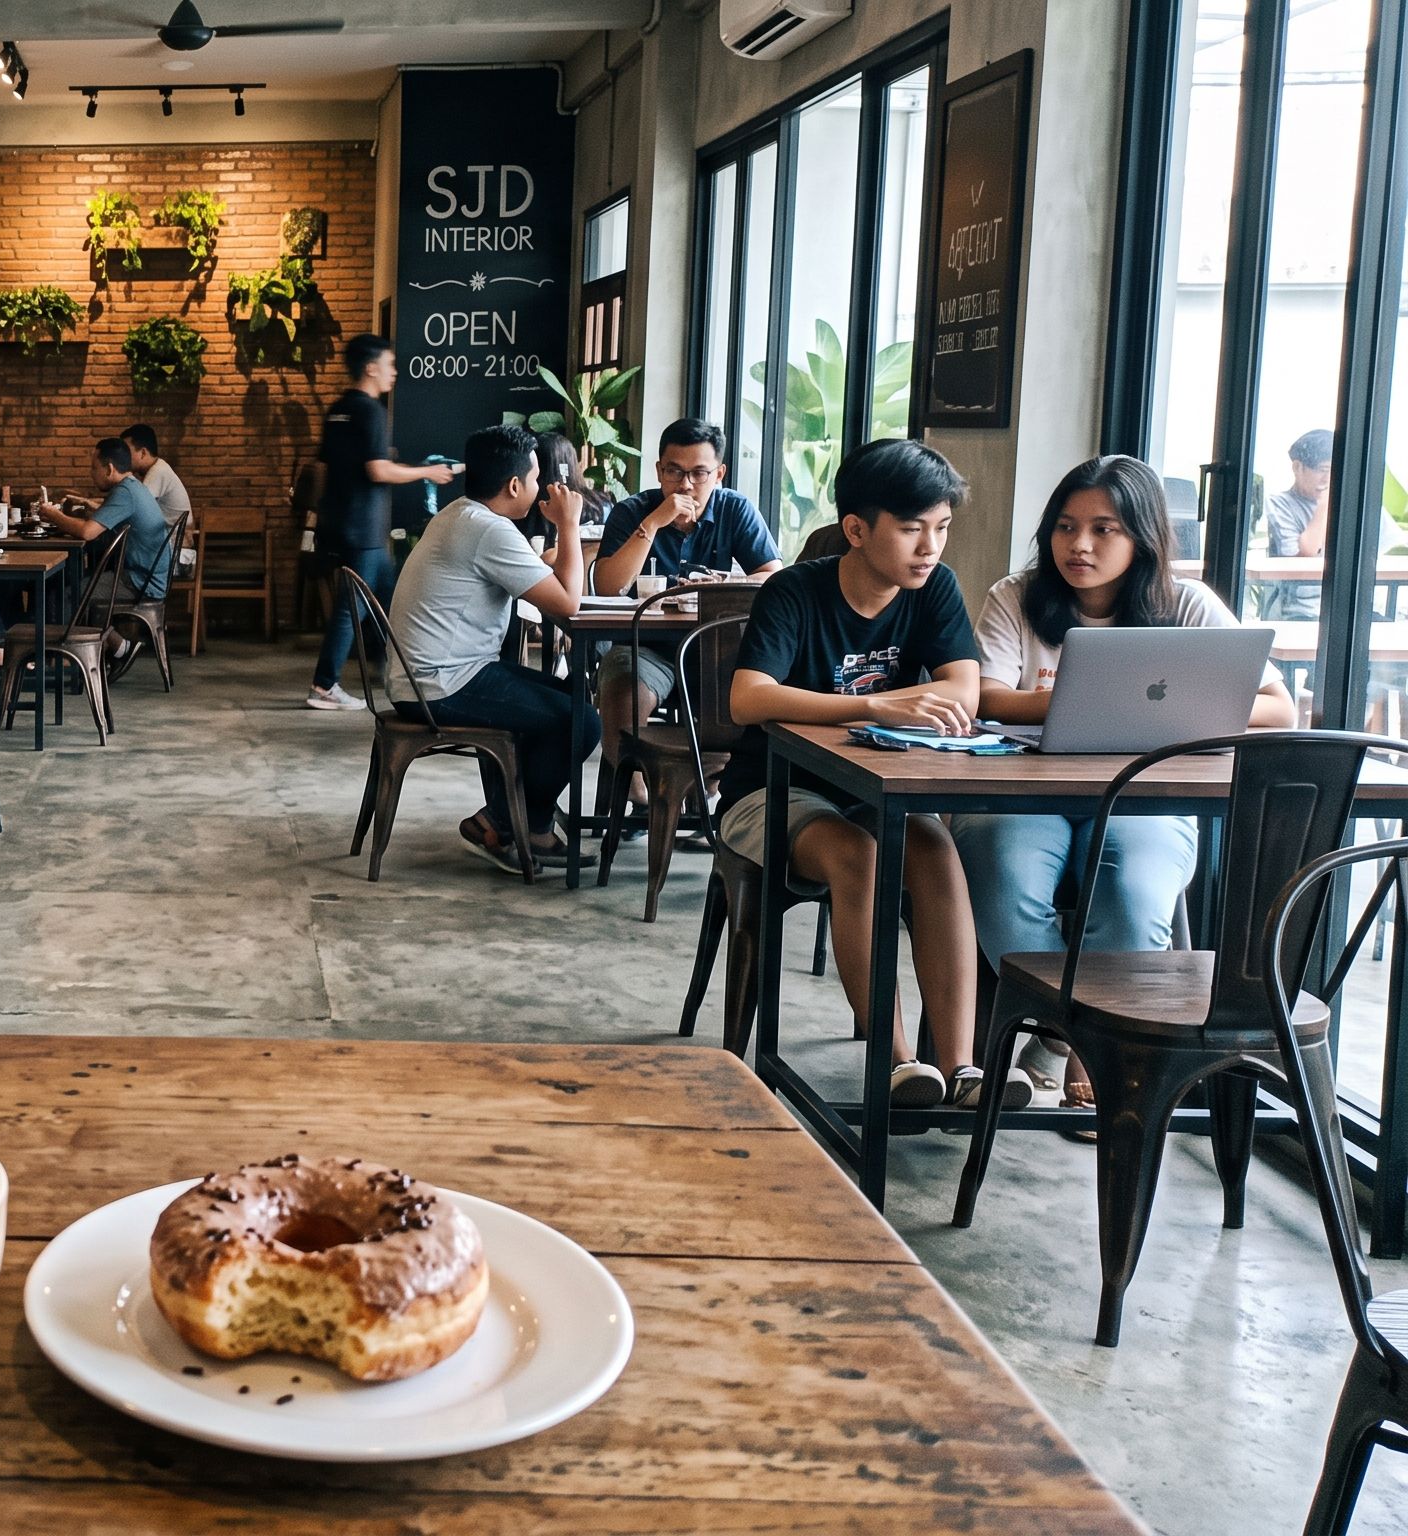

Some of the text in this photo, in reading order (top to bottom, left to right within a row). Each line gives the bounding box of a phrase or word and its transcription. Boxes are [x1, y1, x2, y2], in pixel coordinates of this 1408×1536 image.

[425, 165, 534, 220] SJD
[425, 225, 534, 253] INTERIOR
[424, 310, 517, 347] OPEN
